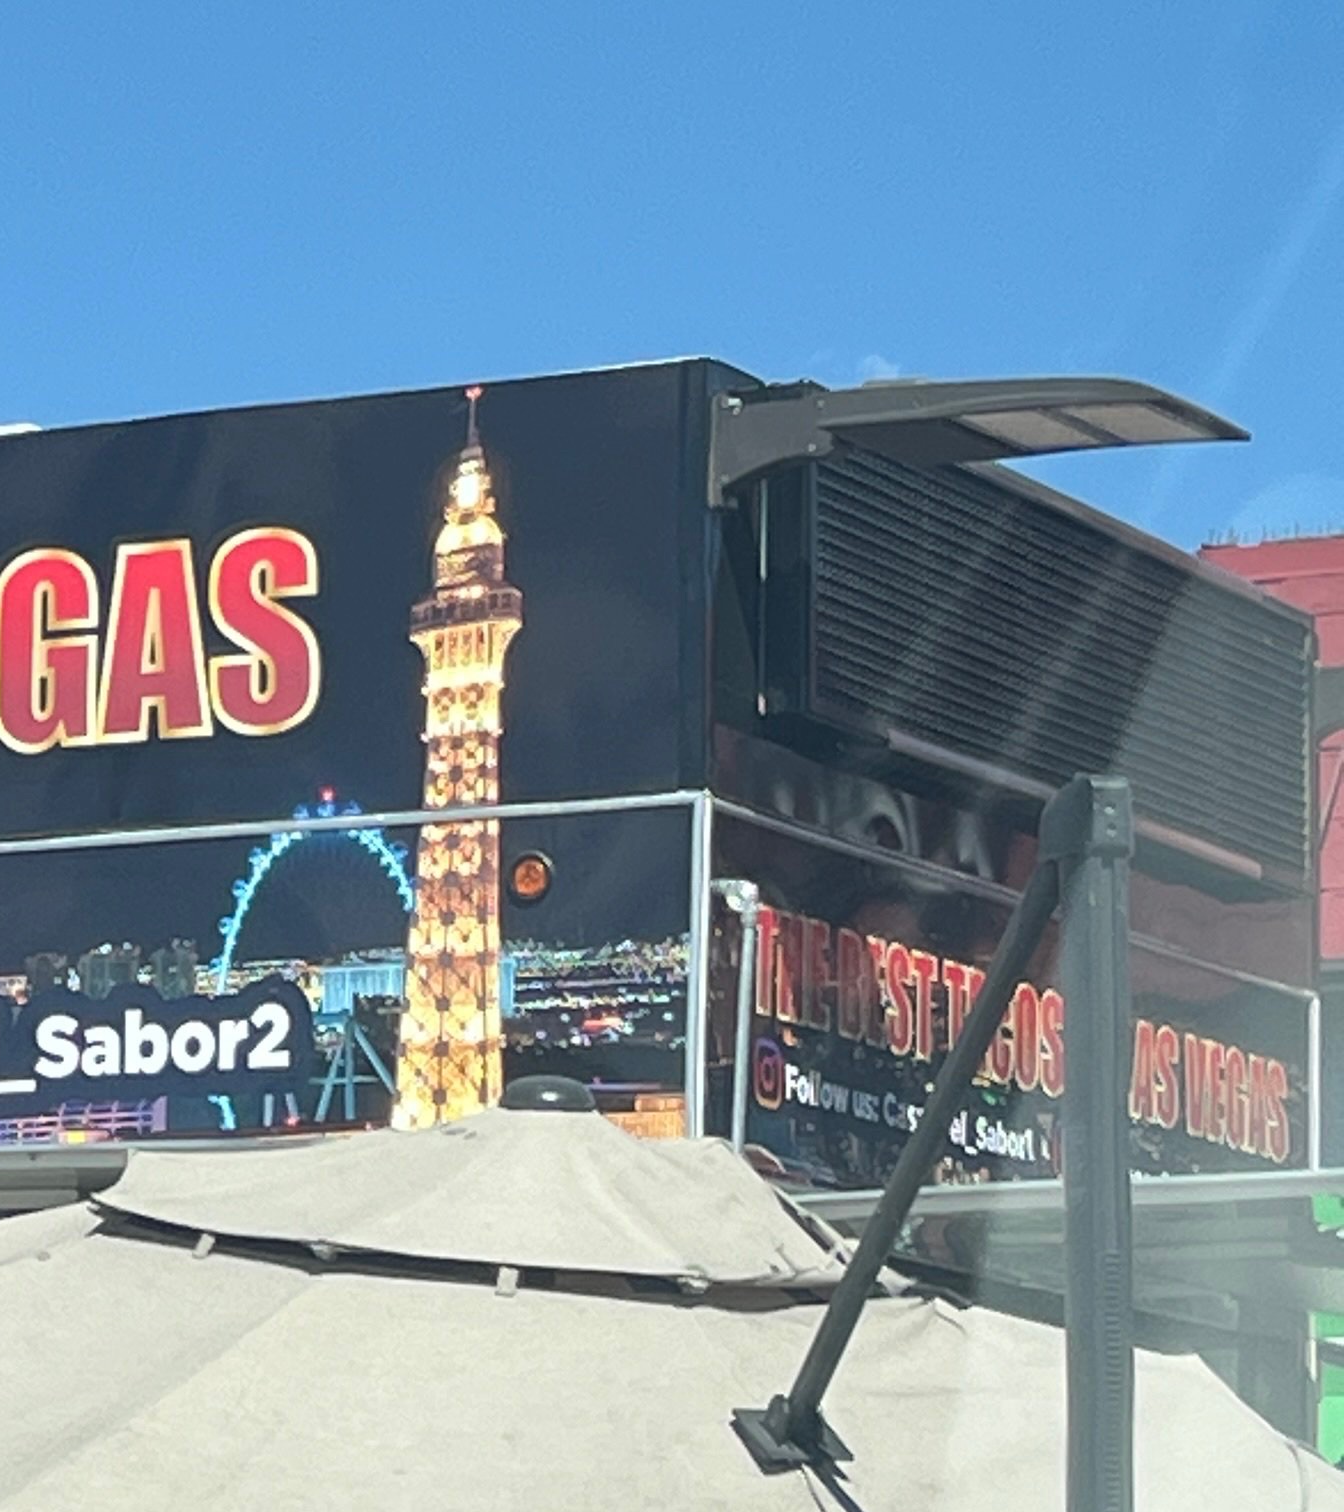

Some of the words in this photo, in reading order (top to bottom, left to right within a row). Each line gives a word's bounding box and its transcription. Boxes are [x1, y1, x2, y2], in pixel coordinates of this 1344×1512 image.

[756, 905, 831, 1034] THE
[838, 927, 938, 1062] BEST
[943, 958, 1064, 1098] TCOS
[785, 1064, 849, 1114] Follow
[1127, 1018, 1179, 1130] AS
[1184, 1031, 1291, 1163] VEGAS
